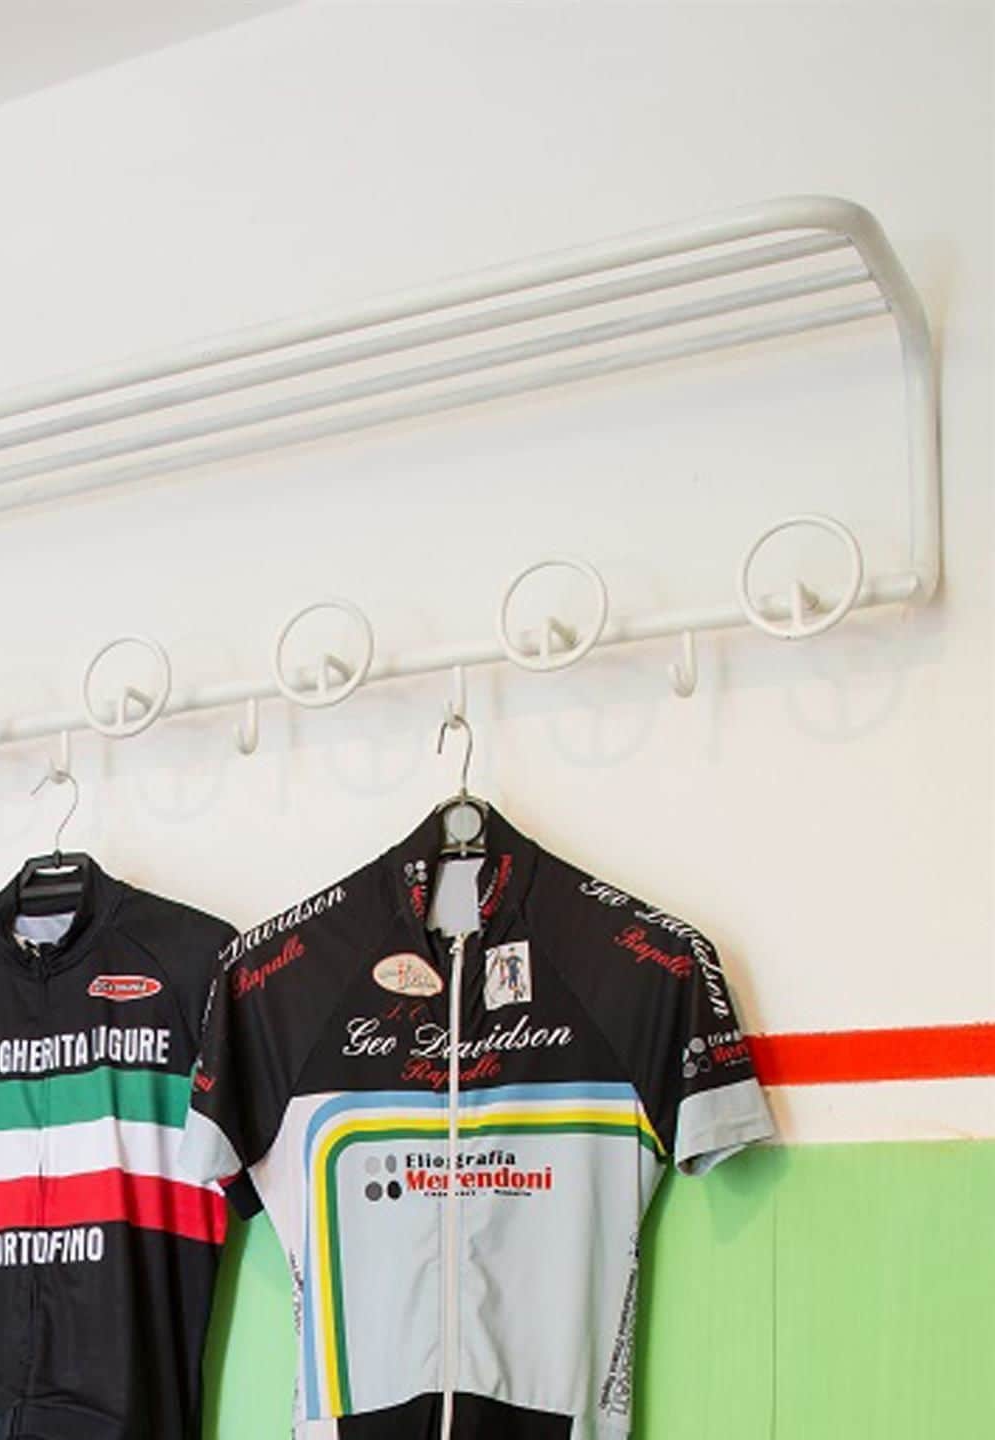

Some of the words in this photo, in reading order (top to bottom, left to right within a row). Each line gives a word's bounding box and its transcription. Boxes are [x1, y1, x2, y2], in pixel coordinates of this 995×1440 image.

[91, 1025, 171, 1064] LIGURE
[341, 1016, 397, 1056] Geo
[409, 1014, 573, 1059] Davidson
[405, 1150, 516, 1170] Eliografia
